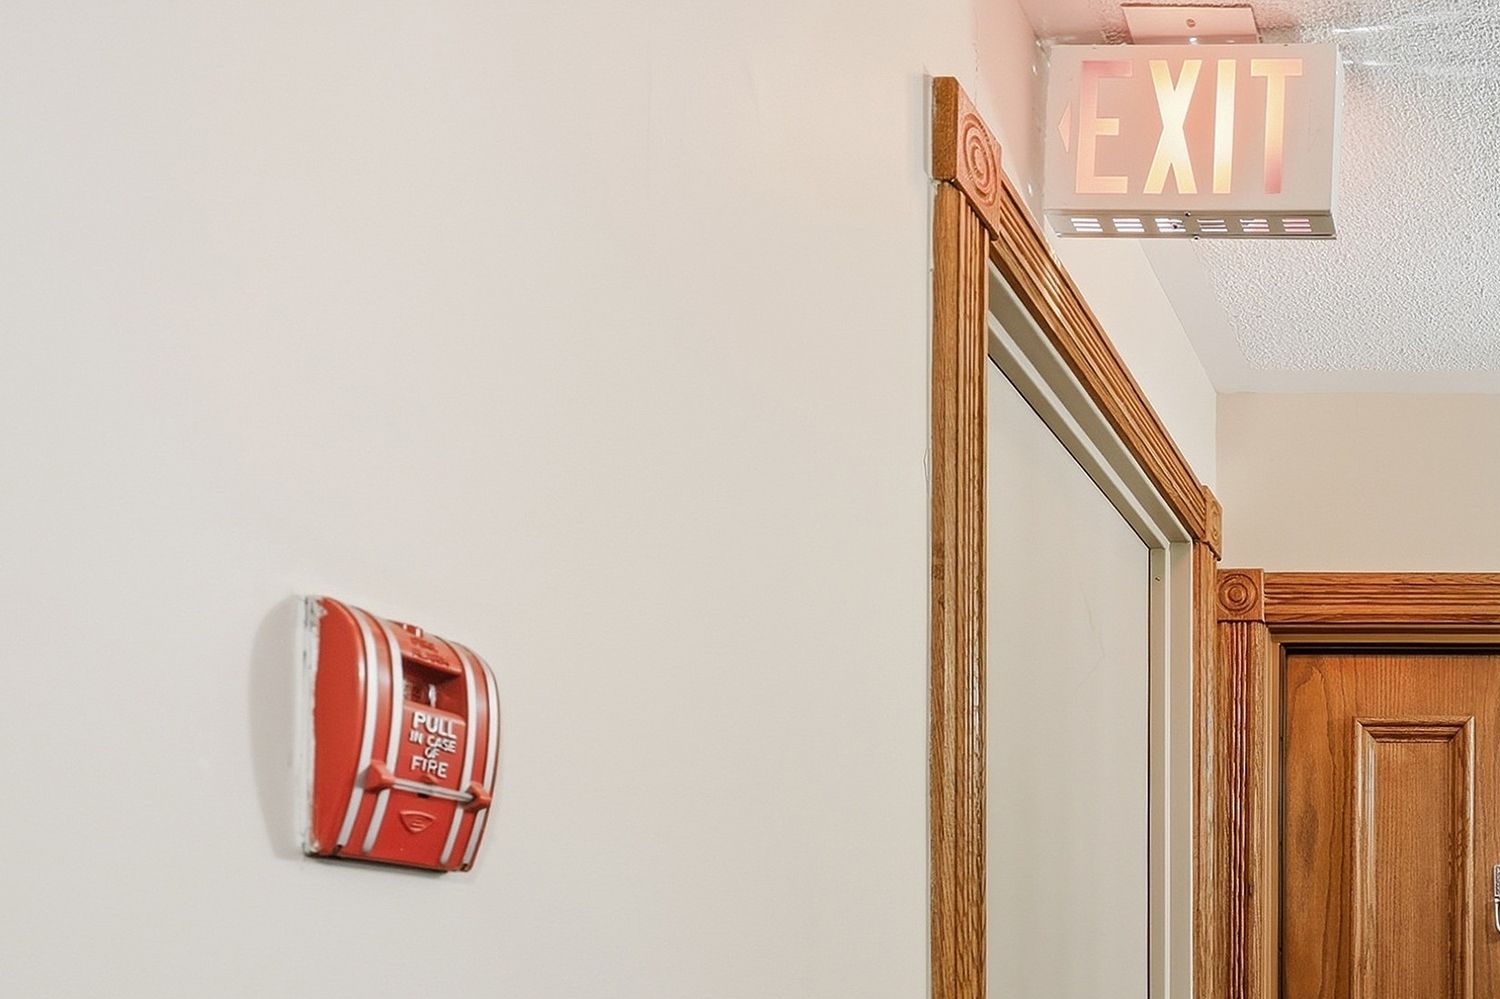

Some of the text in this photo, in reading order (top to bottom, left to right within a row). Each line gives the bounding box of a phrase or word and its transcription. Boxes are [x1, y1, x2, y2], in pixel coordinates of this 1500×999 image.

[1075, 58, 1303, 195] EXIT
[413, 711, 457, 739] PULL
[409, 730, 457, 753] IN CASE
[425, 746, 440, 759] OF
[411, 755, 449, 778] FIRE
